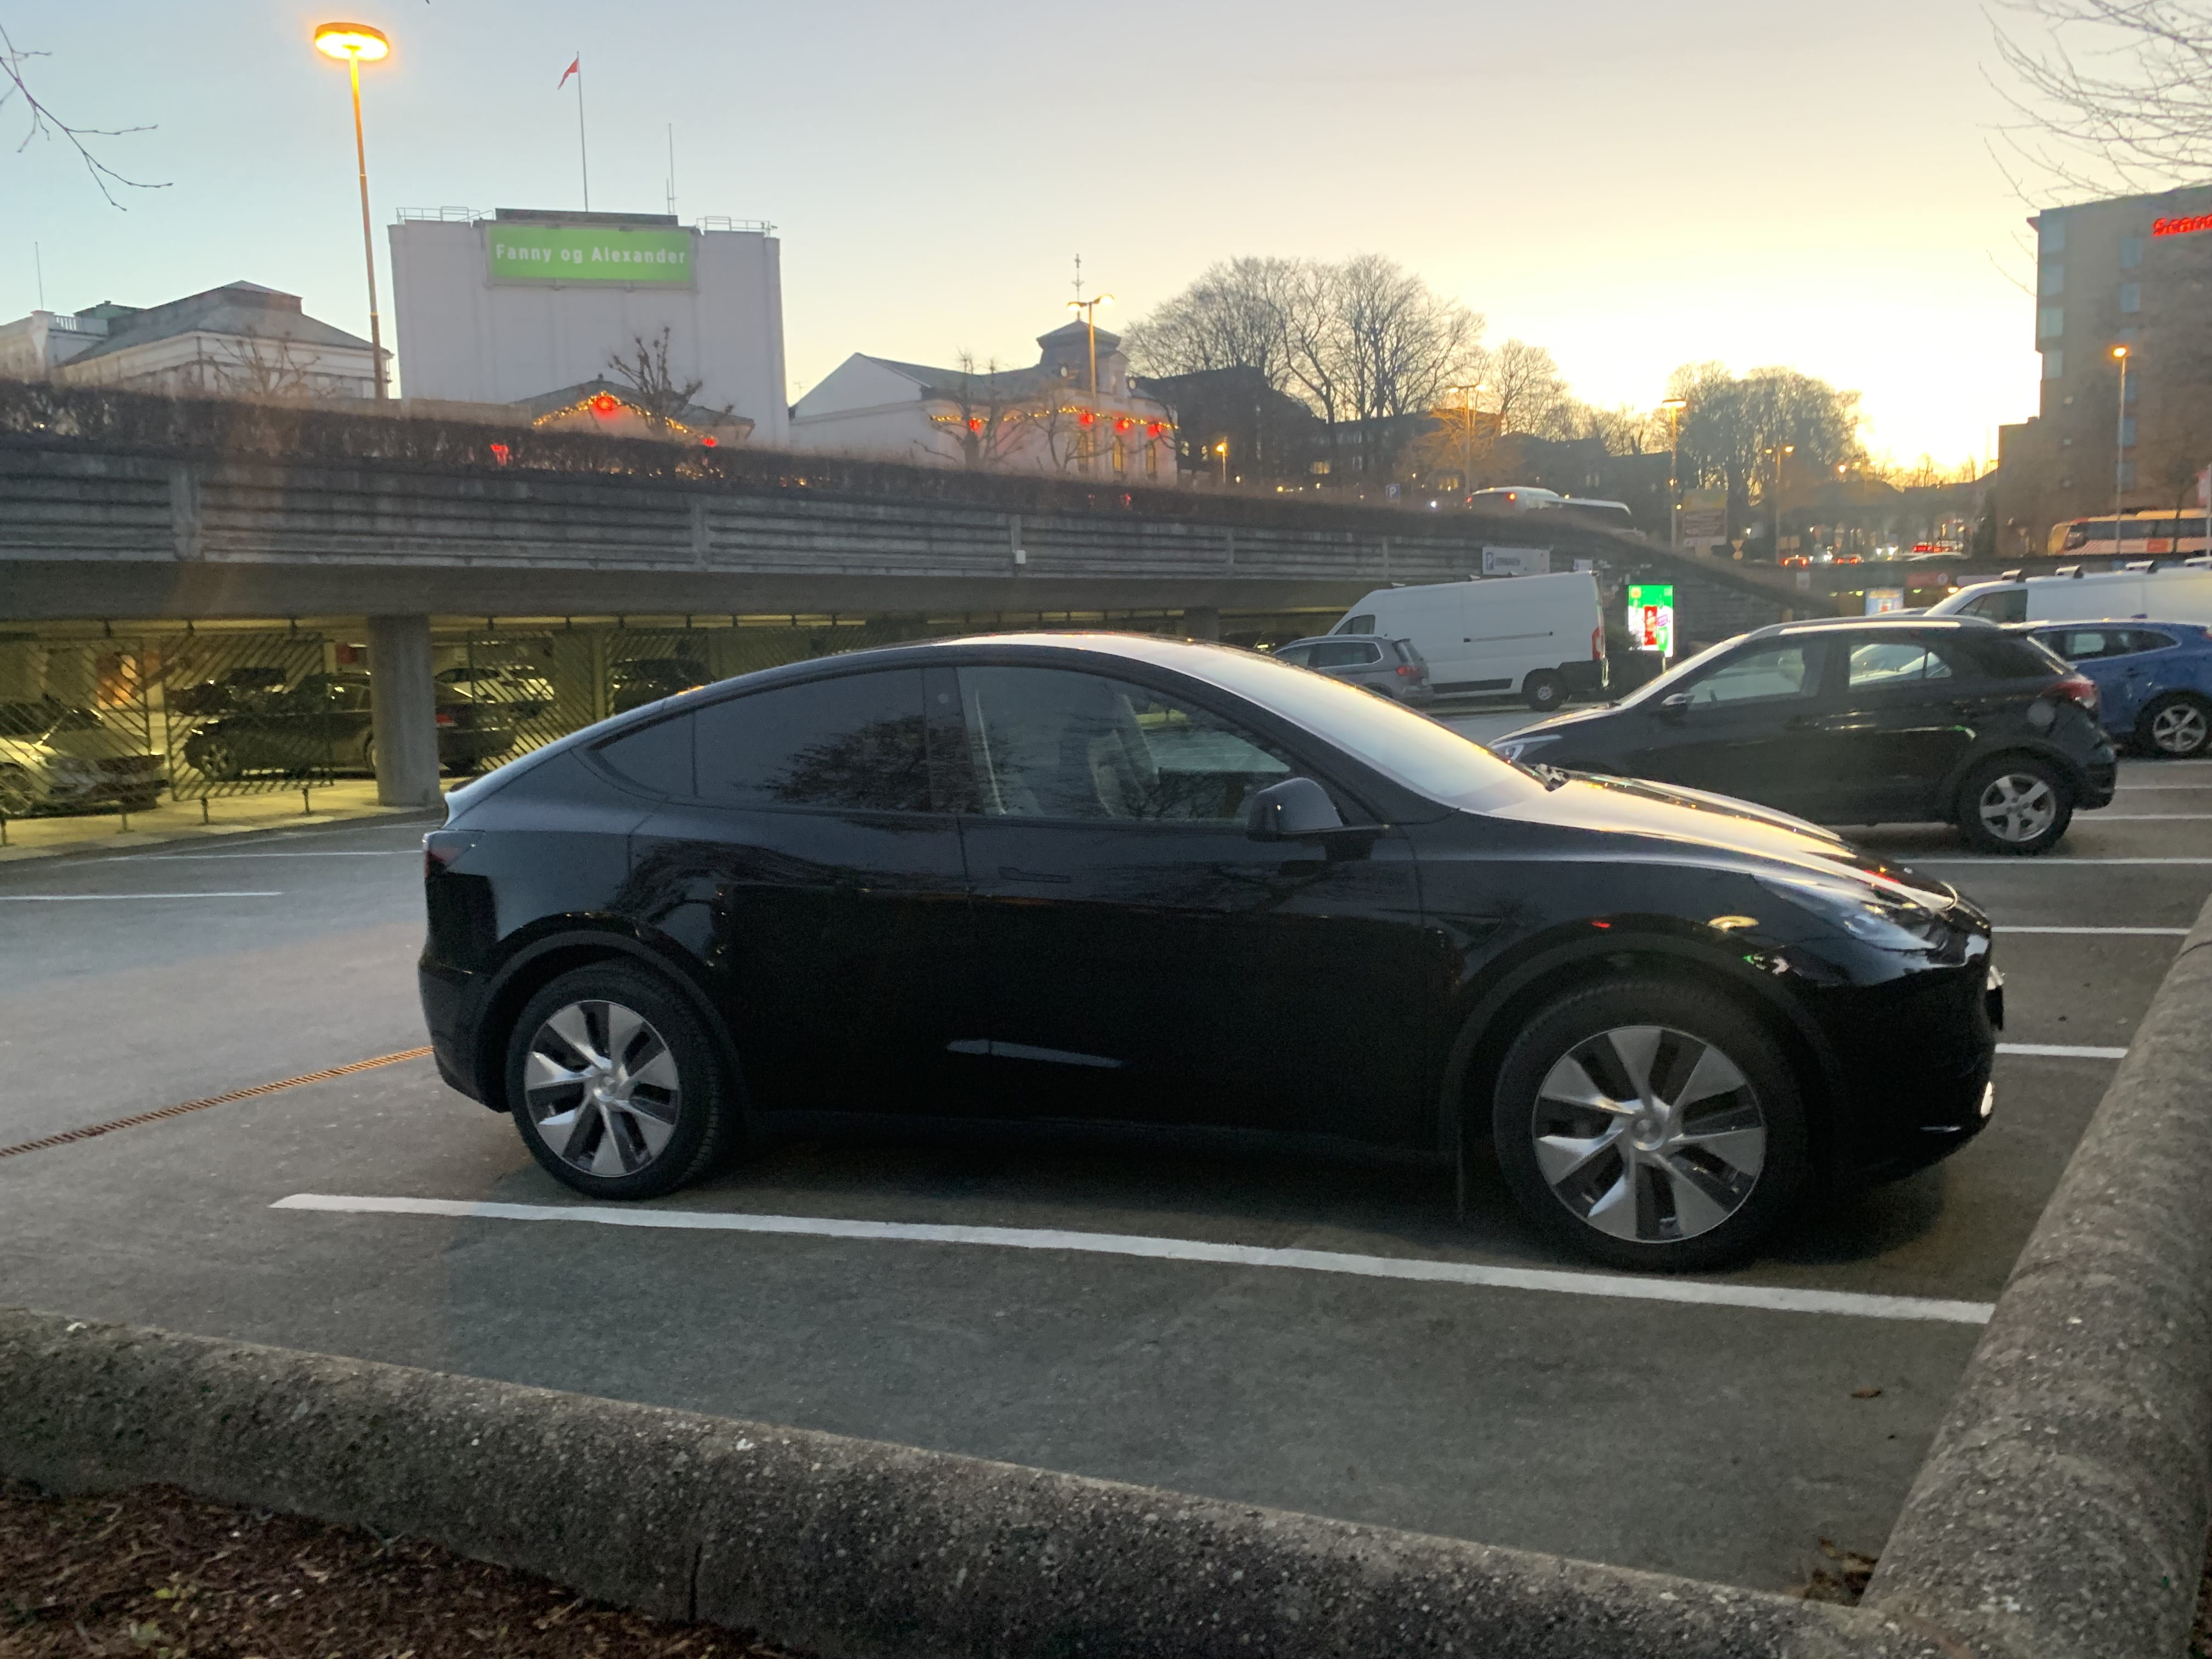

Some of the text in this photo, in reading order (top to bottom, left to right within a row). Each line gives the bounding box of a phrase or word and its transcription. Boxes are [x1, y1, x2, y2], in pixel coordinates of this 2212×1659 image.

[495, 244, 685, 264] Fanny og Alexander
